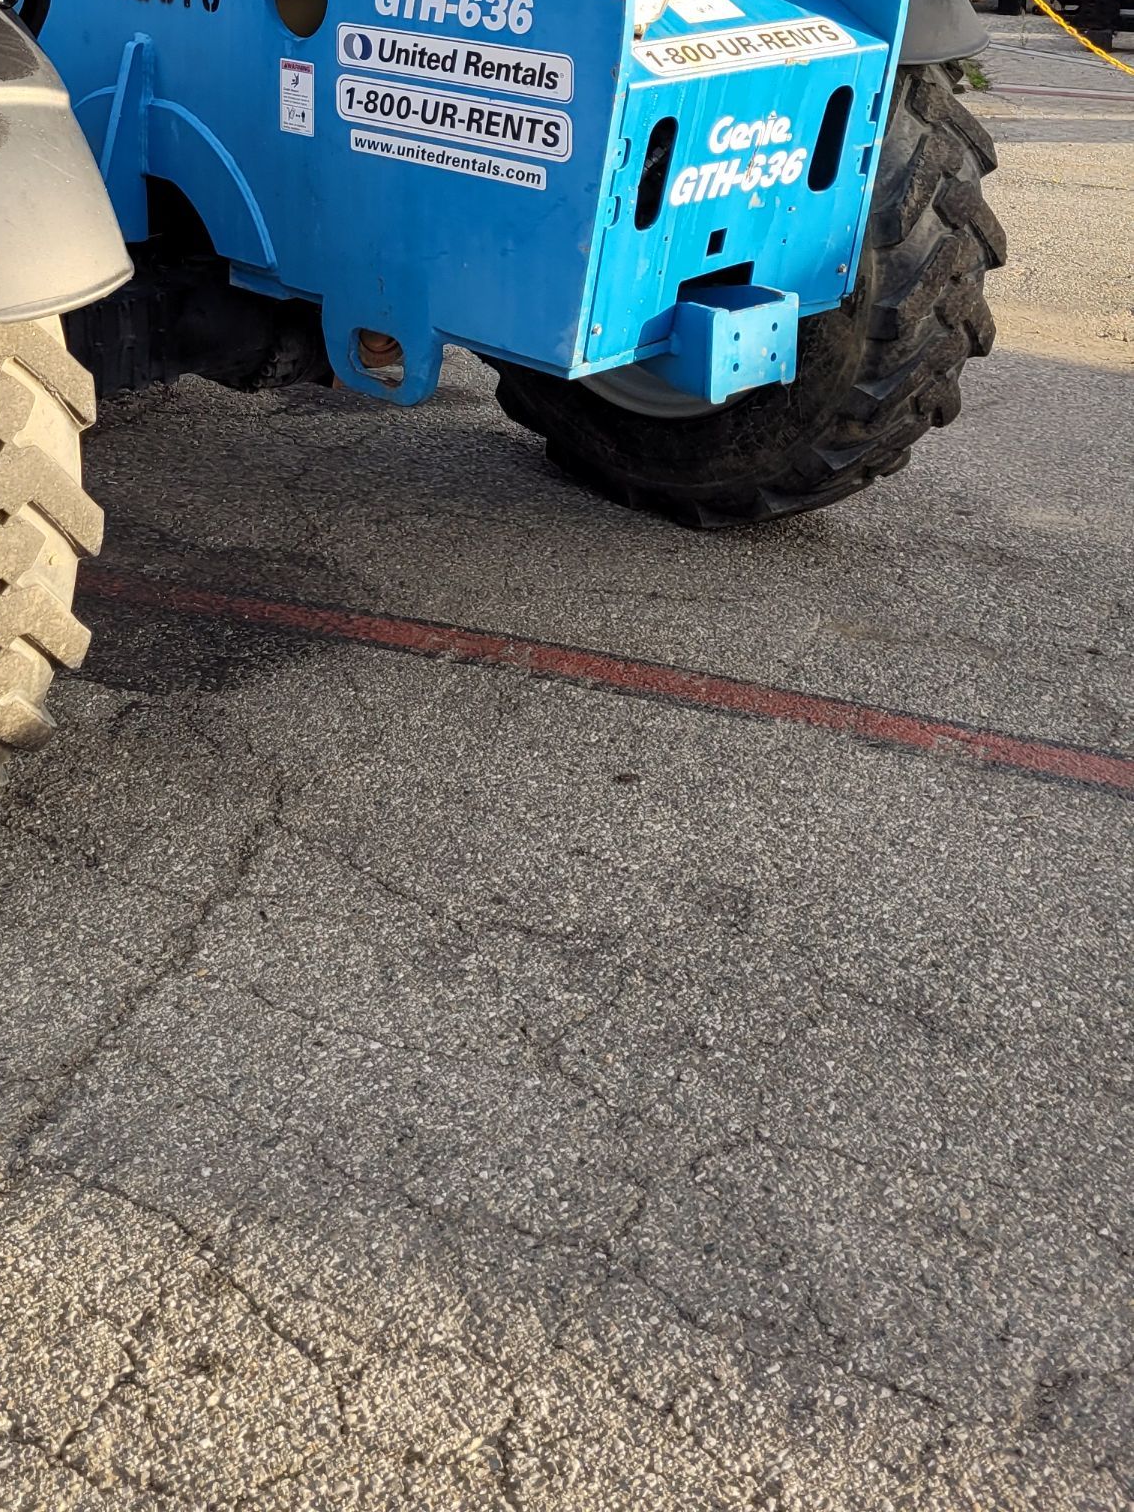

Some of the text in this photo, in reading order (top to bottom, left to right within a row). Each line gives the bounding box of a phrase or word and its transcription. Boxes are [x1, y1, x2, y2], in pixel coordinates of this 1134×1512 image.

[378, 38, 559, 90] United Rentals
[646, 24, 840, 67] 1-800-UR-RENTS
[345, 87, 561, 148] 1-800-UR-RENTS
[708, 110, 791, 154] Genie
[354, 136, 542, 185] www.unitedrentals.com
[669, 147, 808, 206] GTH-636
